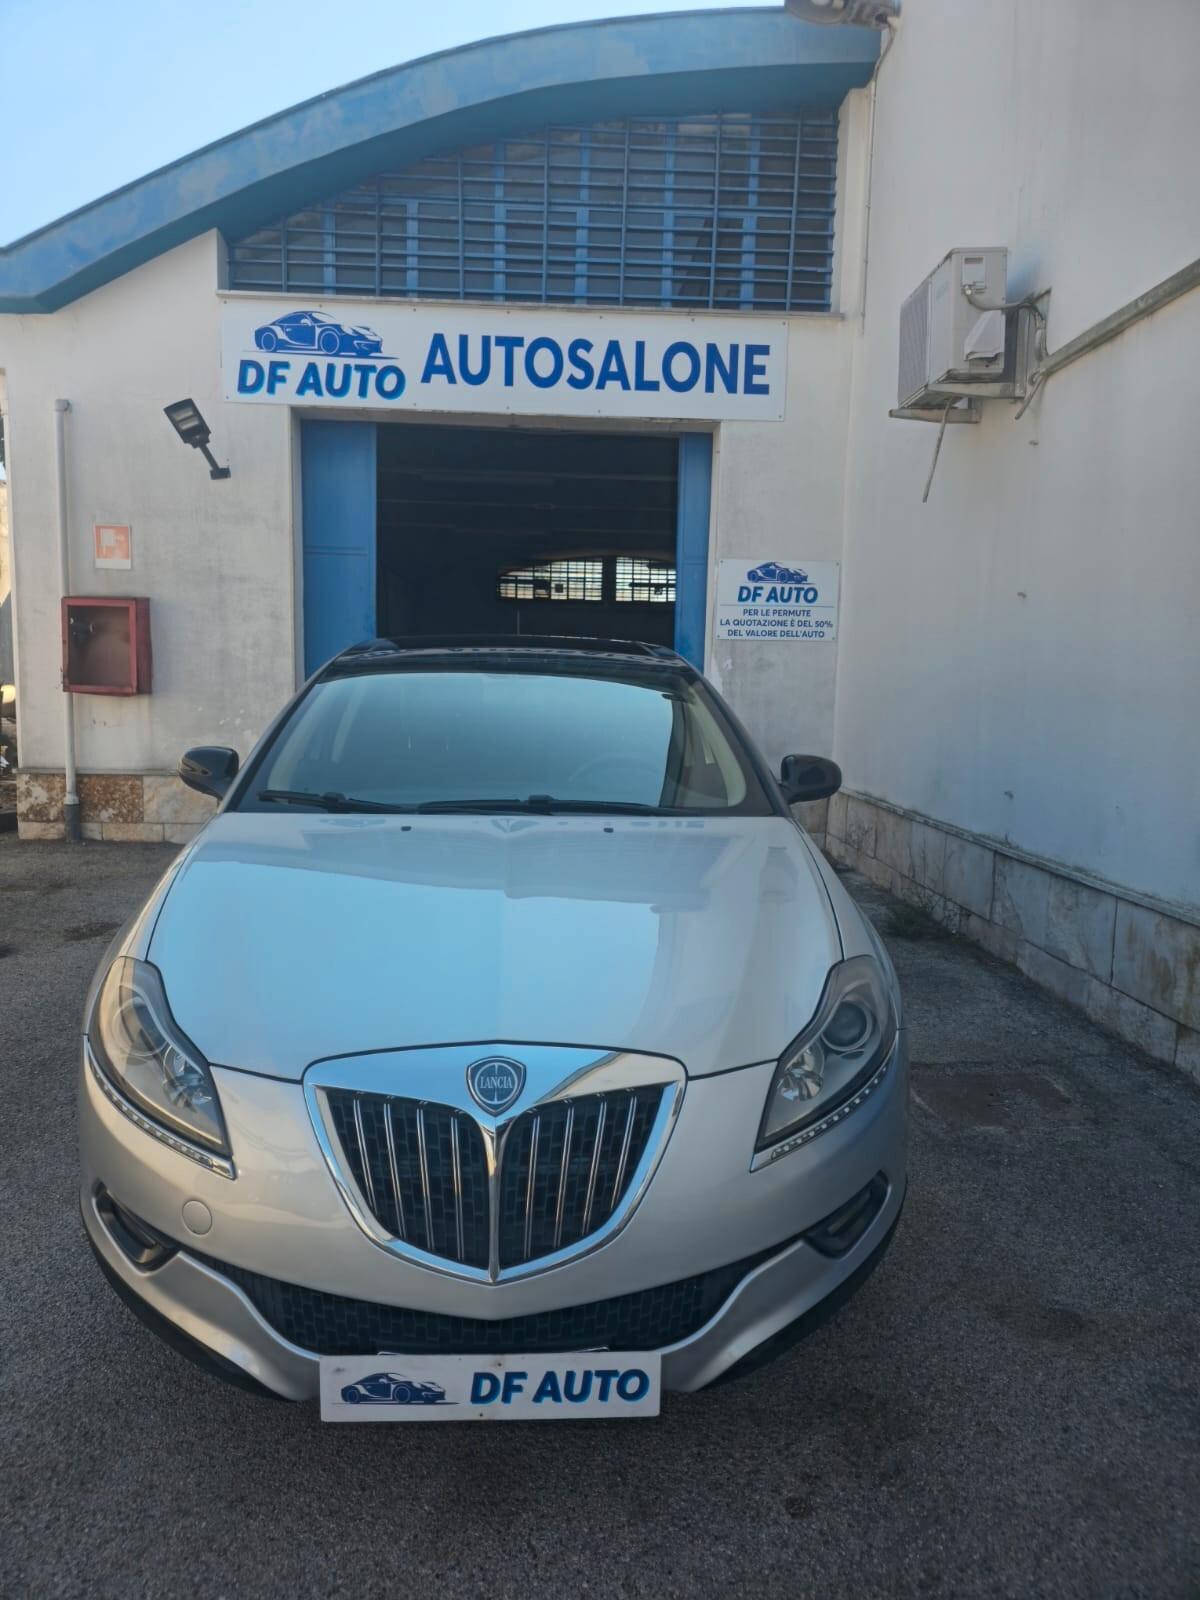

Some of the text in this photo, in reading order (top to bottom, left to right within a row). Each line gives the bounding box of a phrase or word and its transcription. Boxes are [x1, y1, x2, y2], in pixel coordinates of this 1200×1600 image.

[421, 332, 771, 396] AUTOSALONE
[237, 359, 406, 400] DF AUTO
[737, 586, 819, 604] DF AUTO
[743, 608, 812, 617] PER LE PERMUTE
[732, 619, 788, 628] QUOTAZIONE
[797, 620, 812, 628] DEL
[814, 620, 833, 628] 50%
[727, 629, 825, 639] DEL VALORE DELL'AUTO
[480, 1075, 513, 1089] LANCIA
[469, 1368, 650, 1405] DF AUTO
